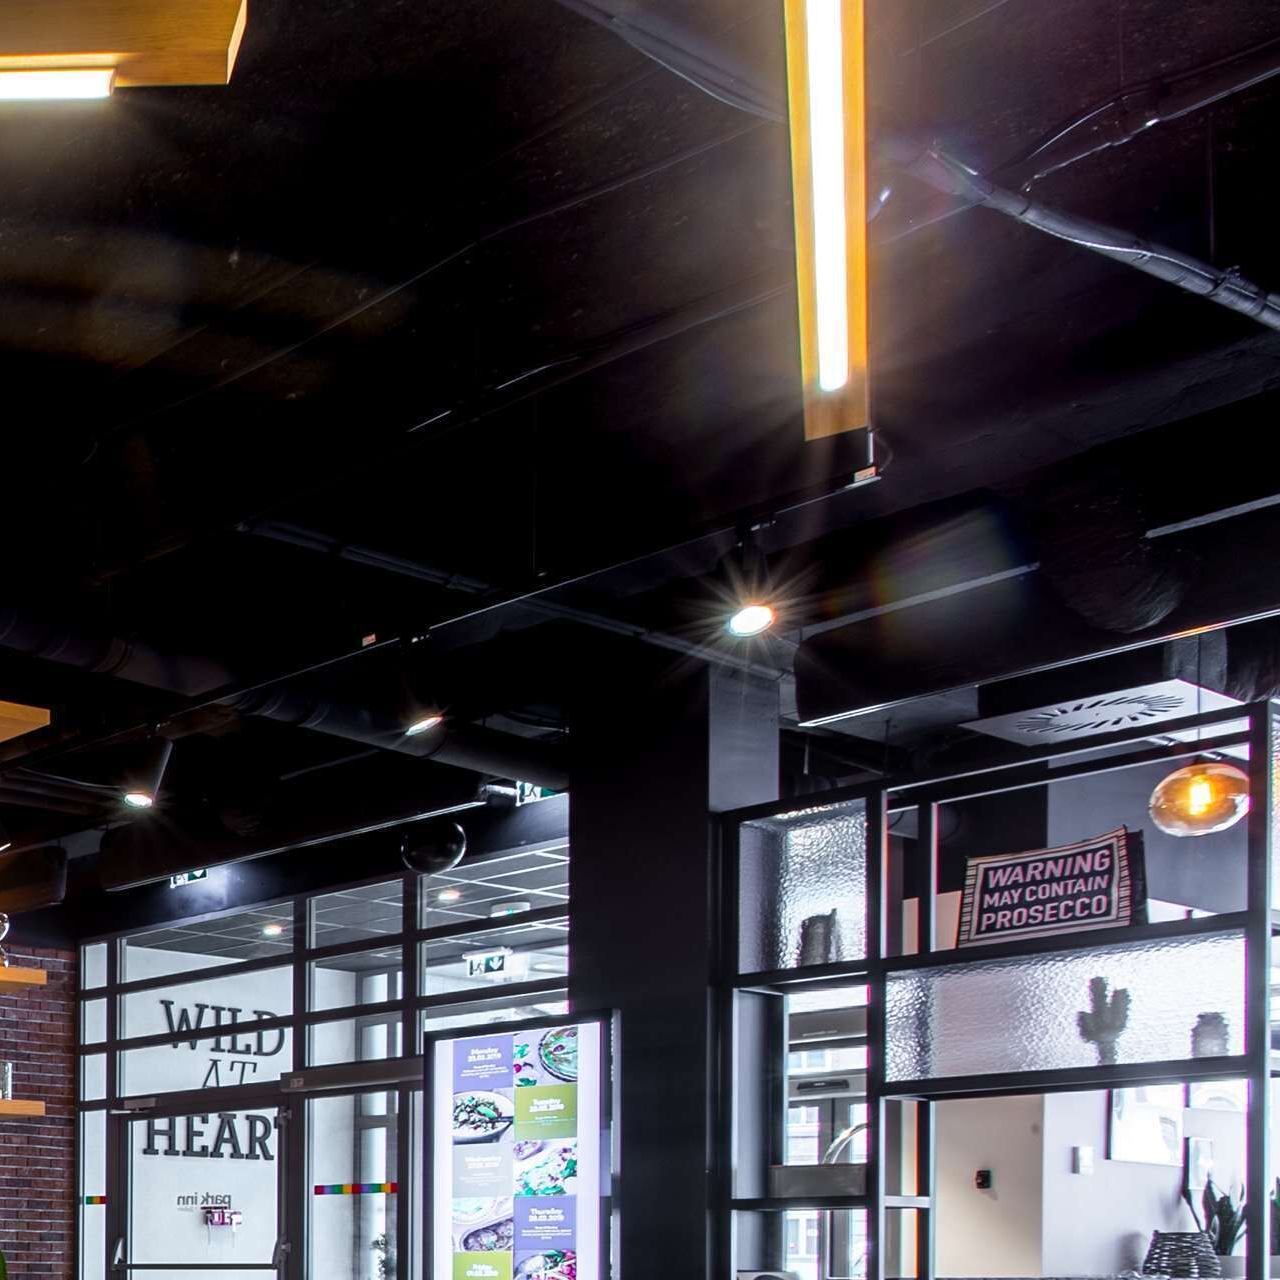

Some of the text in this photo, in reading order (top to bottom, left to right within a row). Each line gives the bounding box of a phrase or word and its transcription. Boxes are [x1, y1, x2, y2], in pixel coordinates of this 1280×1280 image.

[988, 849, 1111, 888] WARNING
[983, 874, 1109, 909] MAY CONTAIN
[981, 894, 1108, 931] PROSECCO
[159, 1000, 285, 1056] WILD
[202, 1059, 257, 1088] AT
[143, 1112, 278, 1161] HEAR
